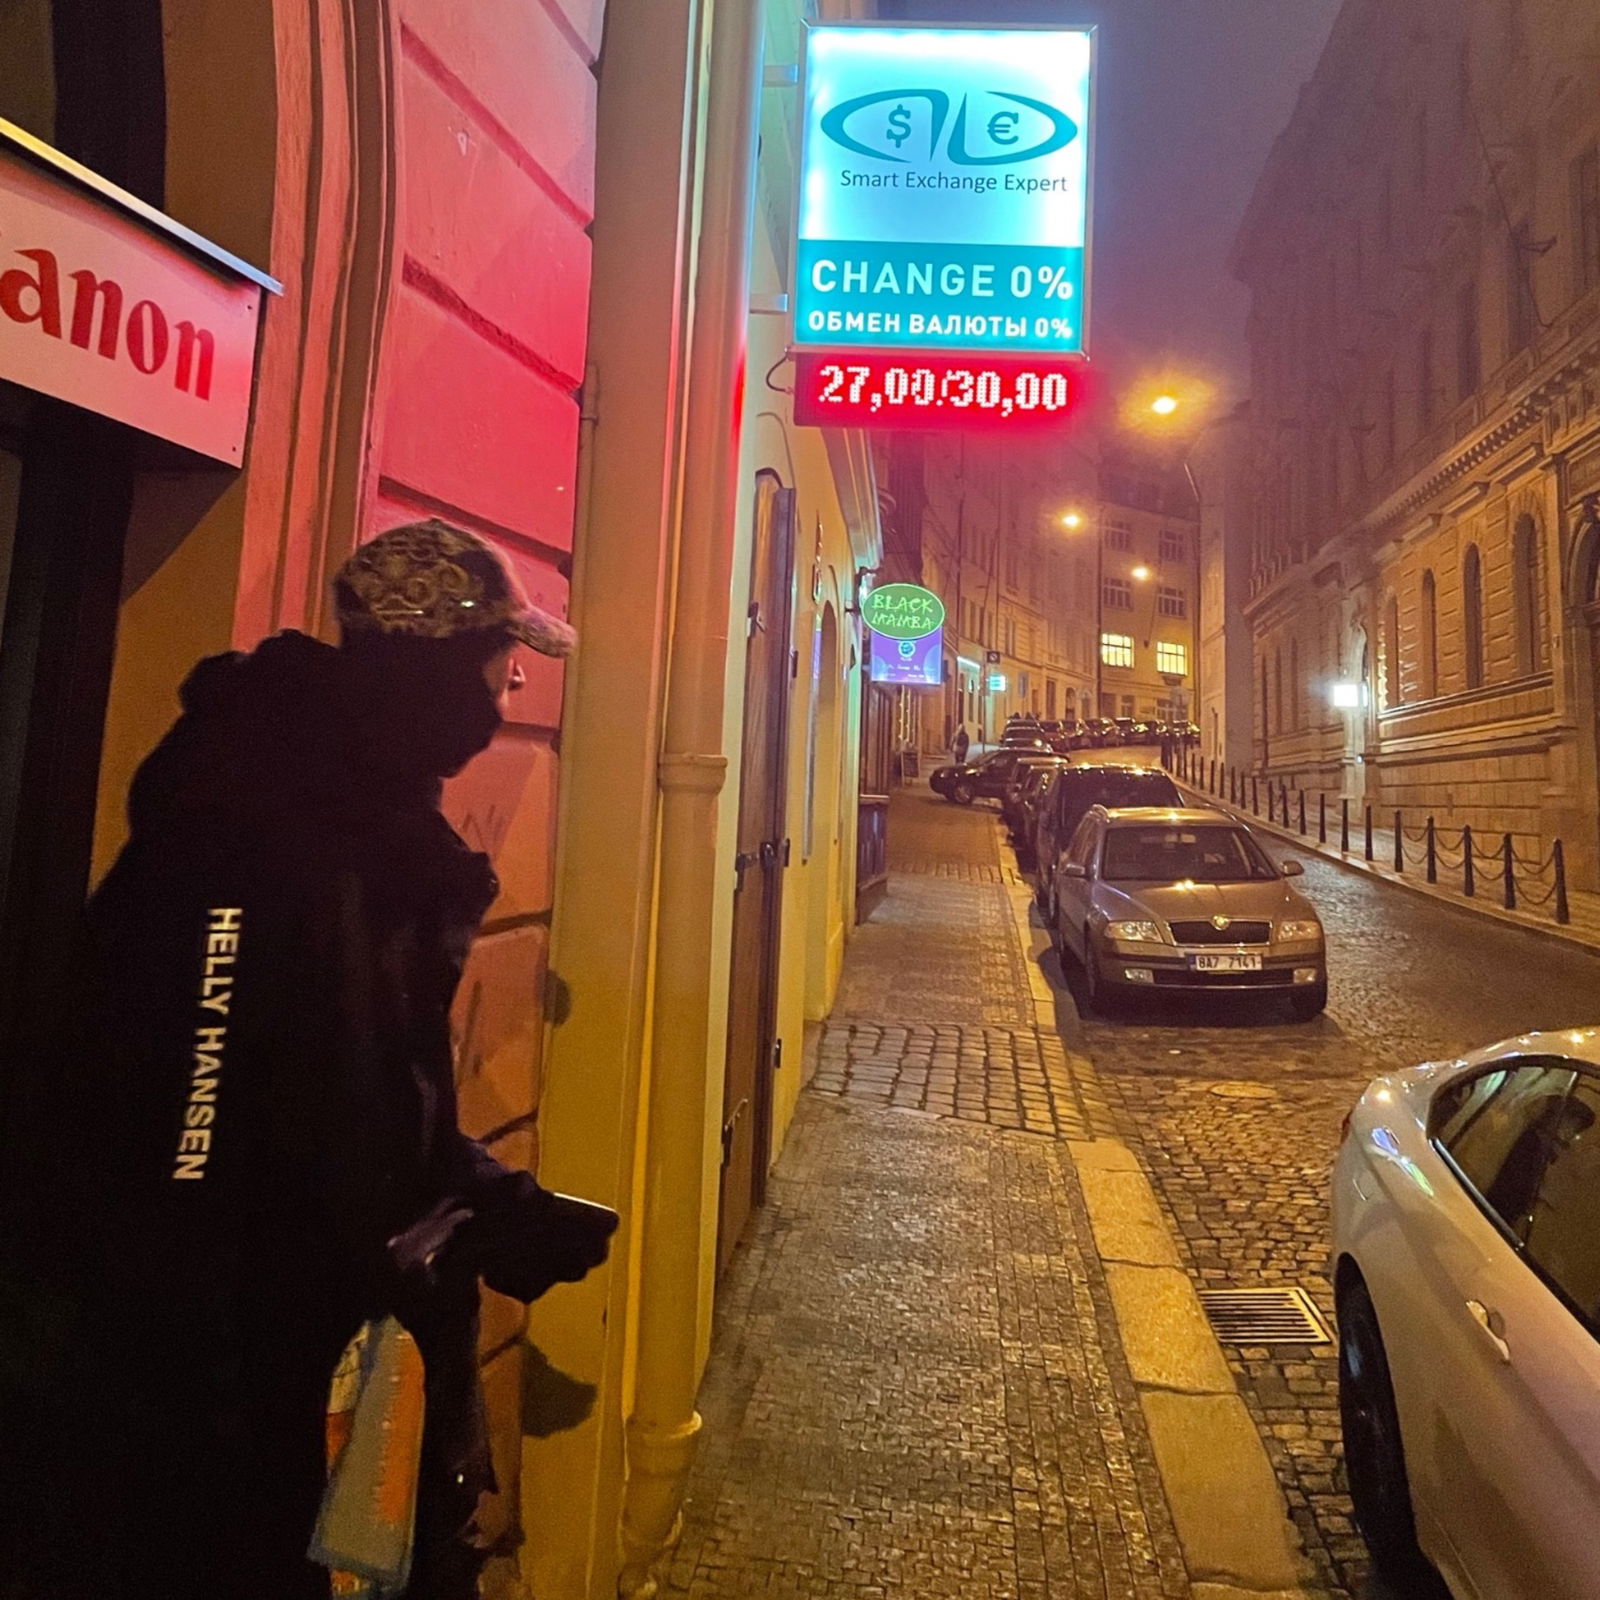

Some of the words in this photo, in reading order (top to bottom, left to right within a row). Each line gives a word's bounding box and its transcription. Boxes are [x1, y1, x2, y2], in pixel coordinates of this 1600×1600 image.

[840, 169, 899, 189] Smart
[905, 171, 998, 194] Exchange
[1004, 173, 1068, 195] Expert
[811, 259, 996, 298] CHANGE
[1010, 265, 1073, 300] 0%
[0, 248, 215, 402] anon
[808, 310, 900, 334] ОБМЕН
[908, 313, 1027, 338] ВАЛЮТЫ
[1035, 317, 1073, 340] 0%
[871, 594, 934, 614] BLACK
[871, 612, 935, 630] MAMBA
[200, 907, 243, 1016] HELLY
[172, 1027, 228, 1180] HANSEN
